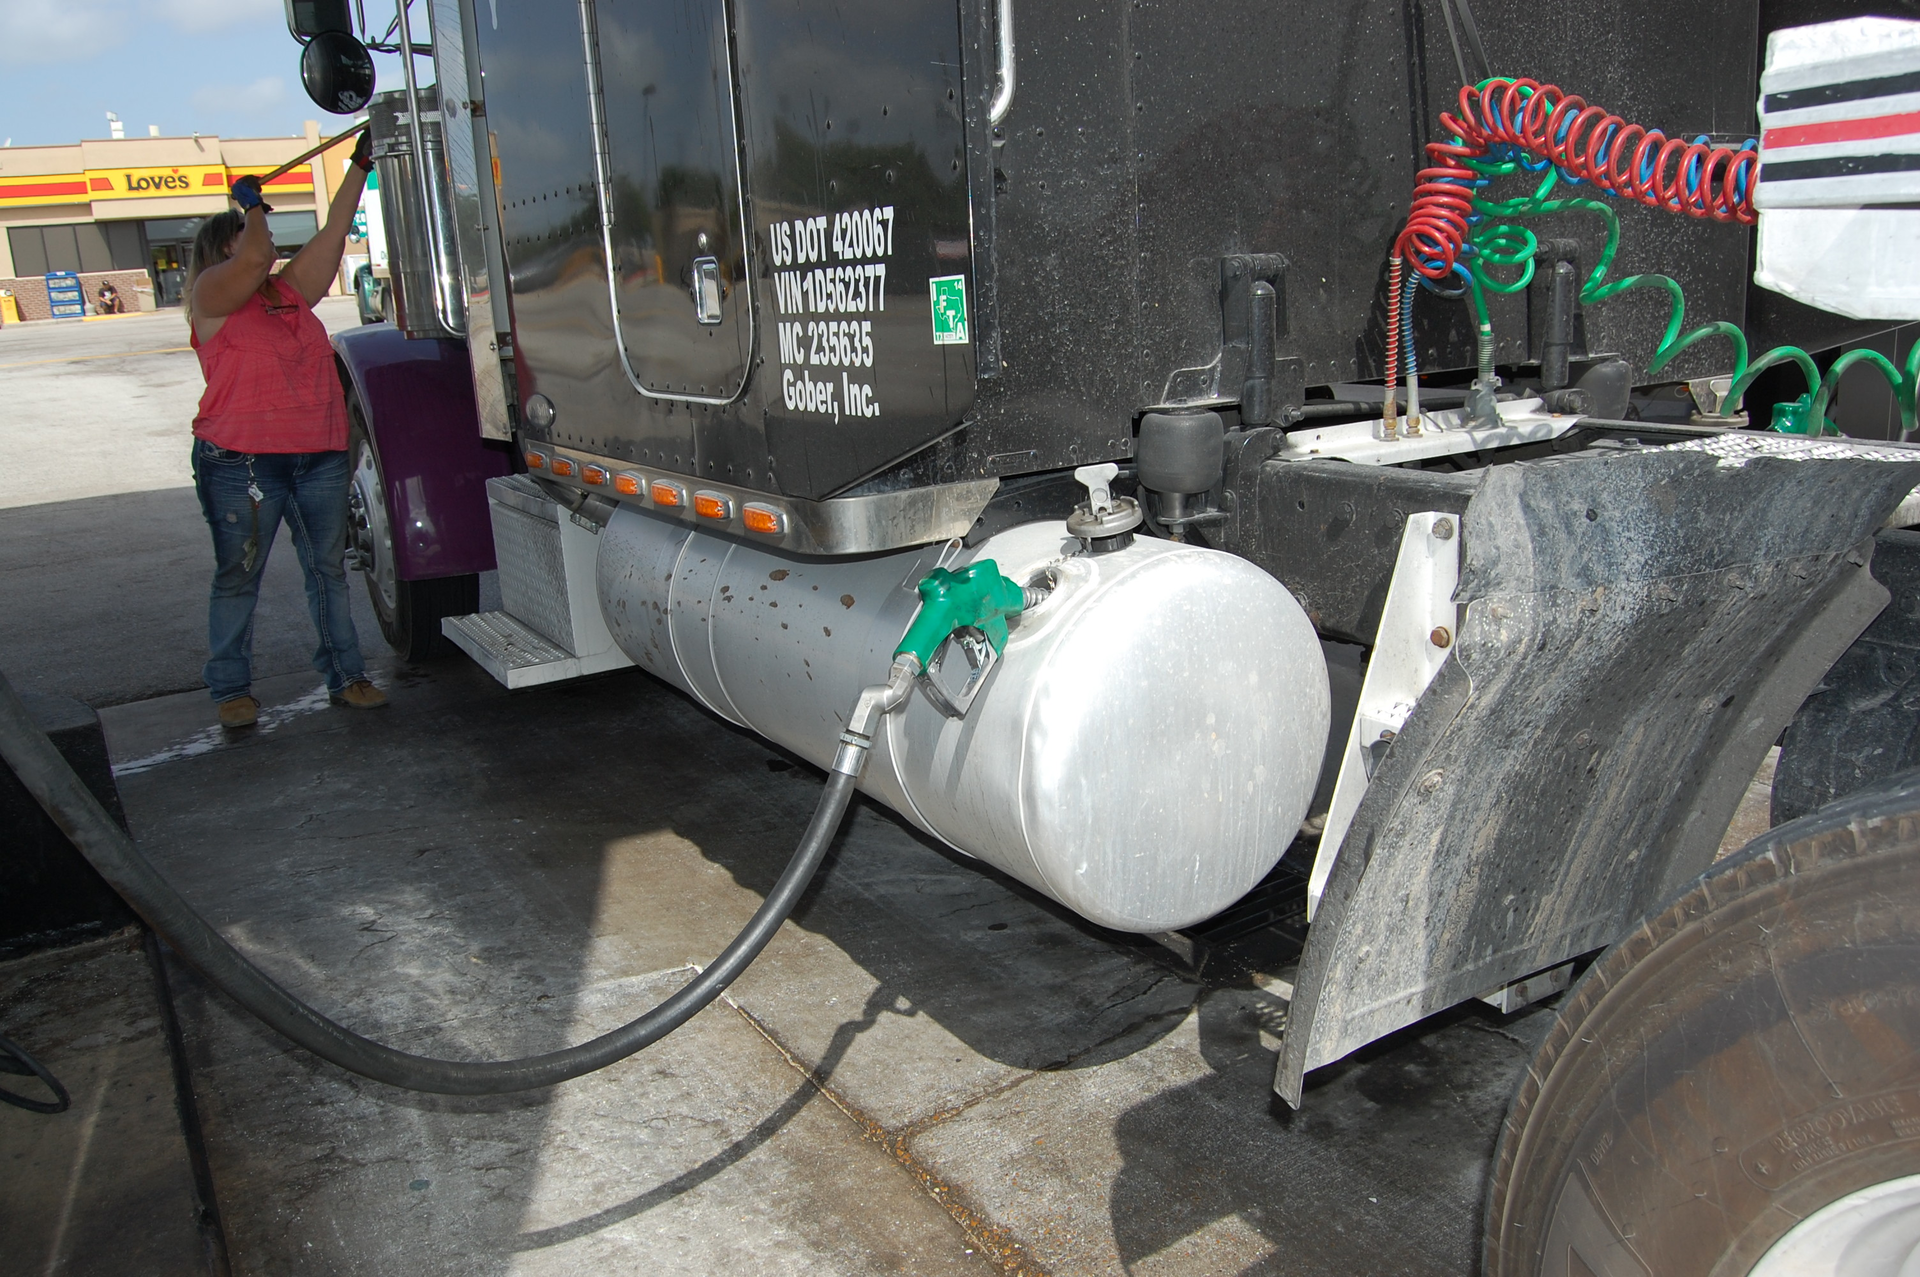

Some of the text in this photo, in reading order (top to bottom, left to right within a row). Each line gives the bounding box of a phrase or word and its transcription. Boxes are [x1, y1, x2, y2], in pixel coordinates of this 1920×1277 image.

[770, 205, 894, 267] US DOT 420067
[774, 263, 886, 314] VIN 1D562377
[778, 320, 874, 367] MC 235635
[783, 368, 881, 425] Gober, Inc.
